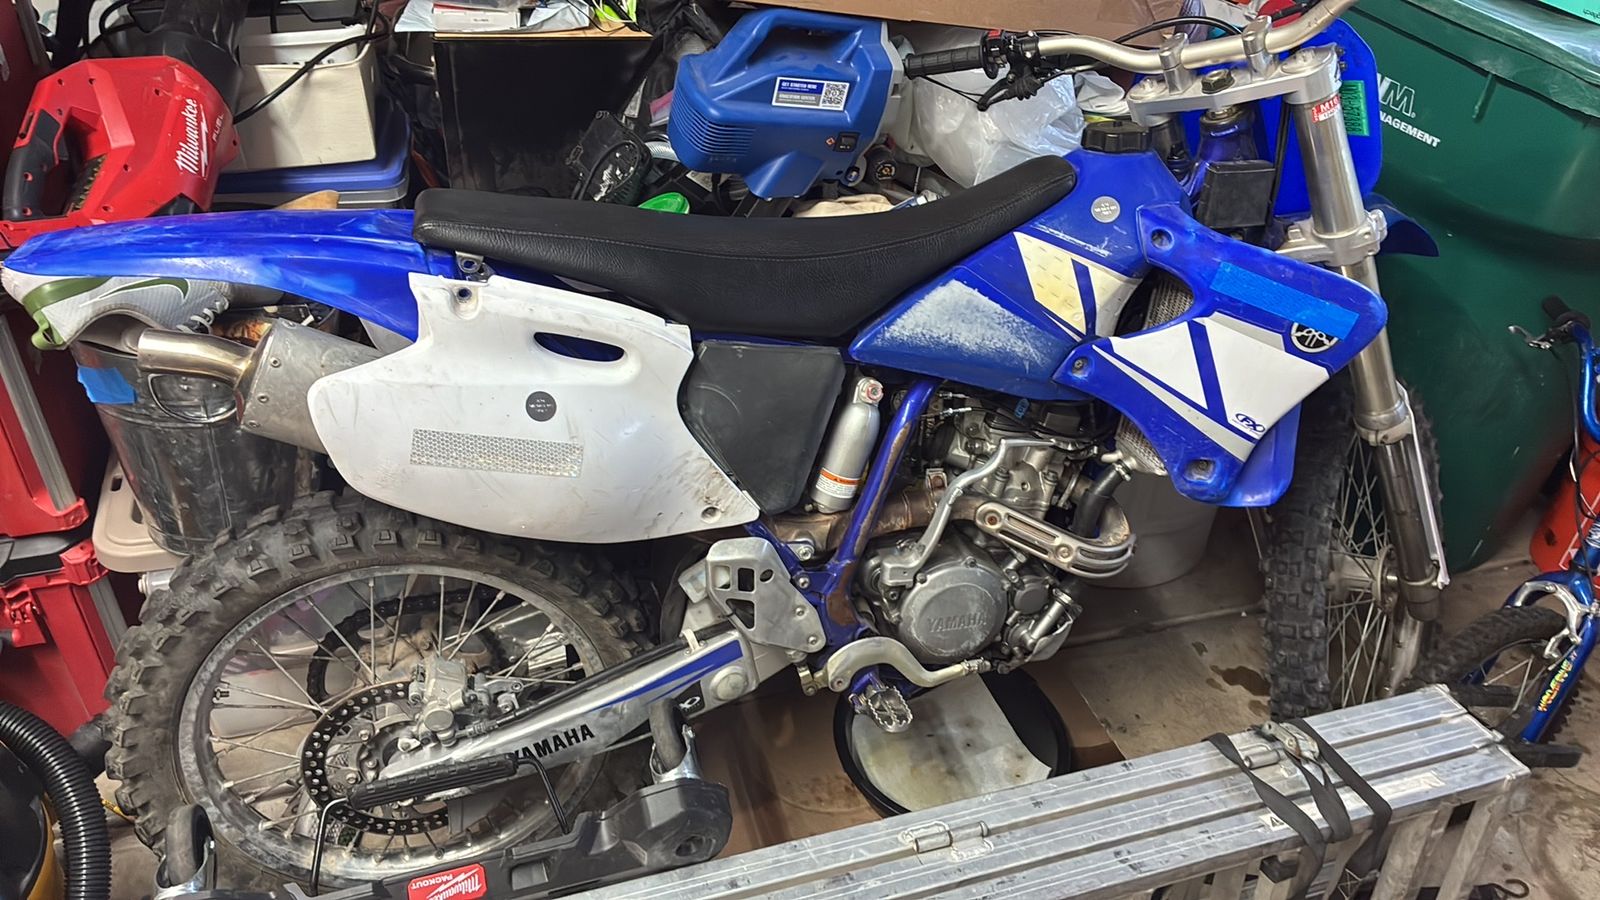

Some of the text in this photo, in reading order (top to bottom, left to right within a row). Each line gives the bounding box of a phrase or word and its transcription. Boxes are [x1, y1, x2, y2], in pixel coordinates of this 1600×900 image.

[174, 98, 200, 174] Milwaukee
[212, 114, 224, 142] FUEL
[1380, 110, 1441, 147] NAGEMENT
[927, 611, 988, 633] YAMAHA
[411, 873, 455, 890] PACKOUT
